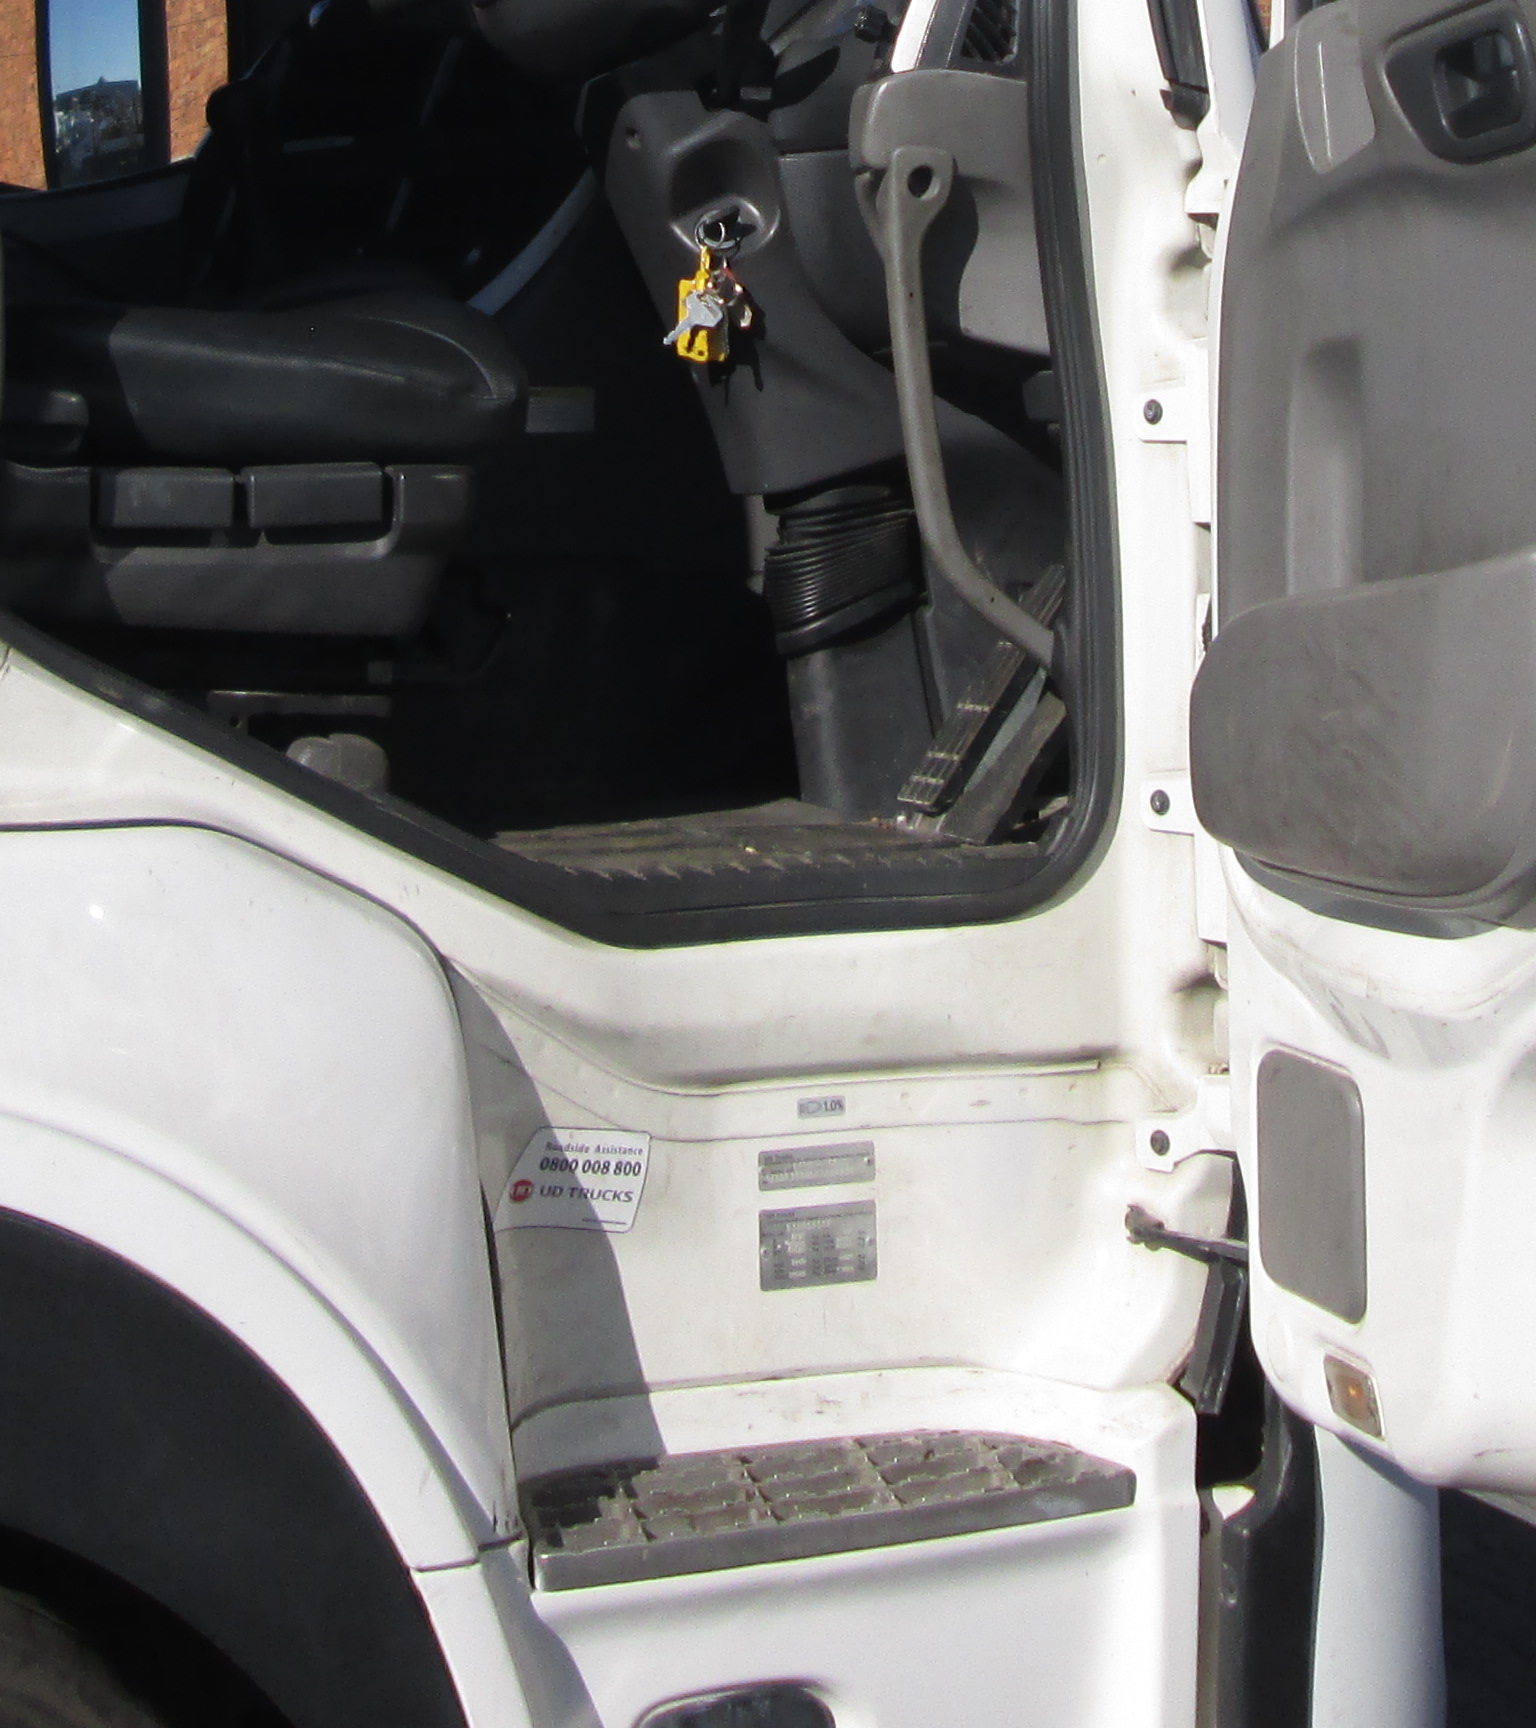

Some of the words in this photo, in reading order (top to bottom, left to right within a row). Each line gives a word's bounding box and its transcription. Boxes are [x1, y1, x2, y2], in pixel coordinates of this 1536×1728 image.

[594, 1144, 643, 1156] Assistance
[539, 1156, 579, 1174] 0800
[582, 1159, 611, 1175] 008
[613, 1160, 642, 1177] 800
[539, 1184, 564, 1198] UD
[568, 1186, 635, 1204] TRUCKS
